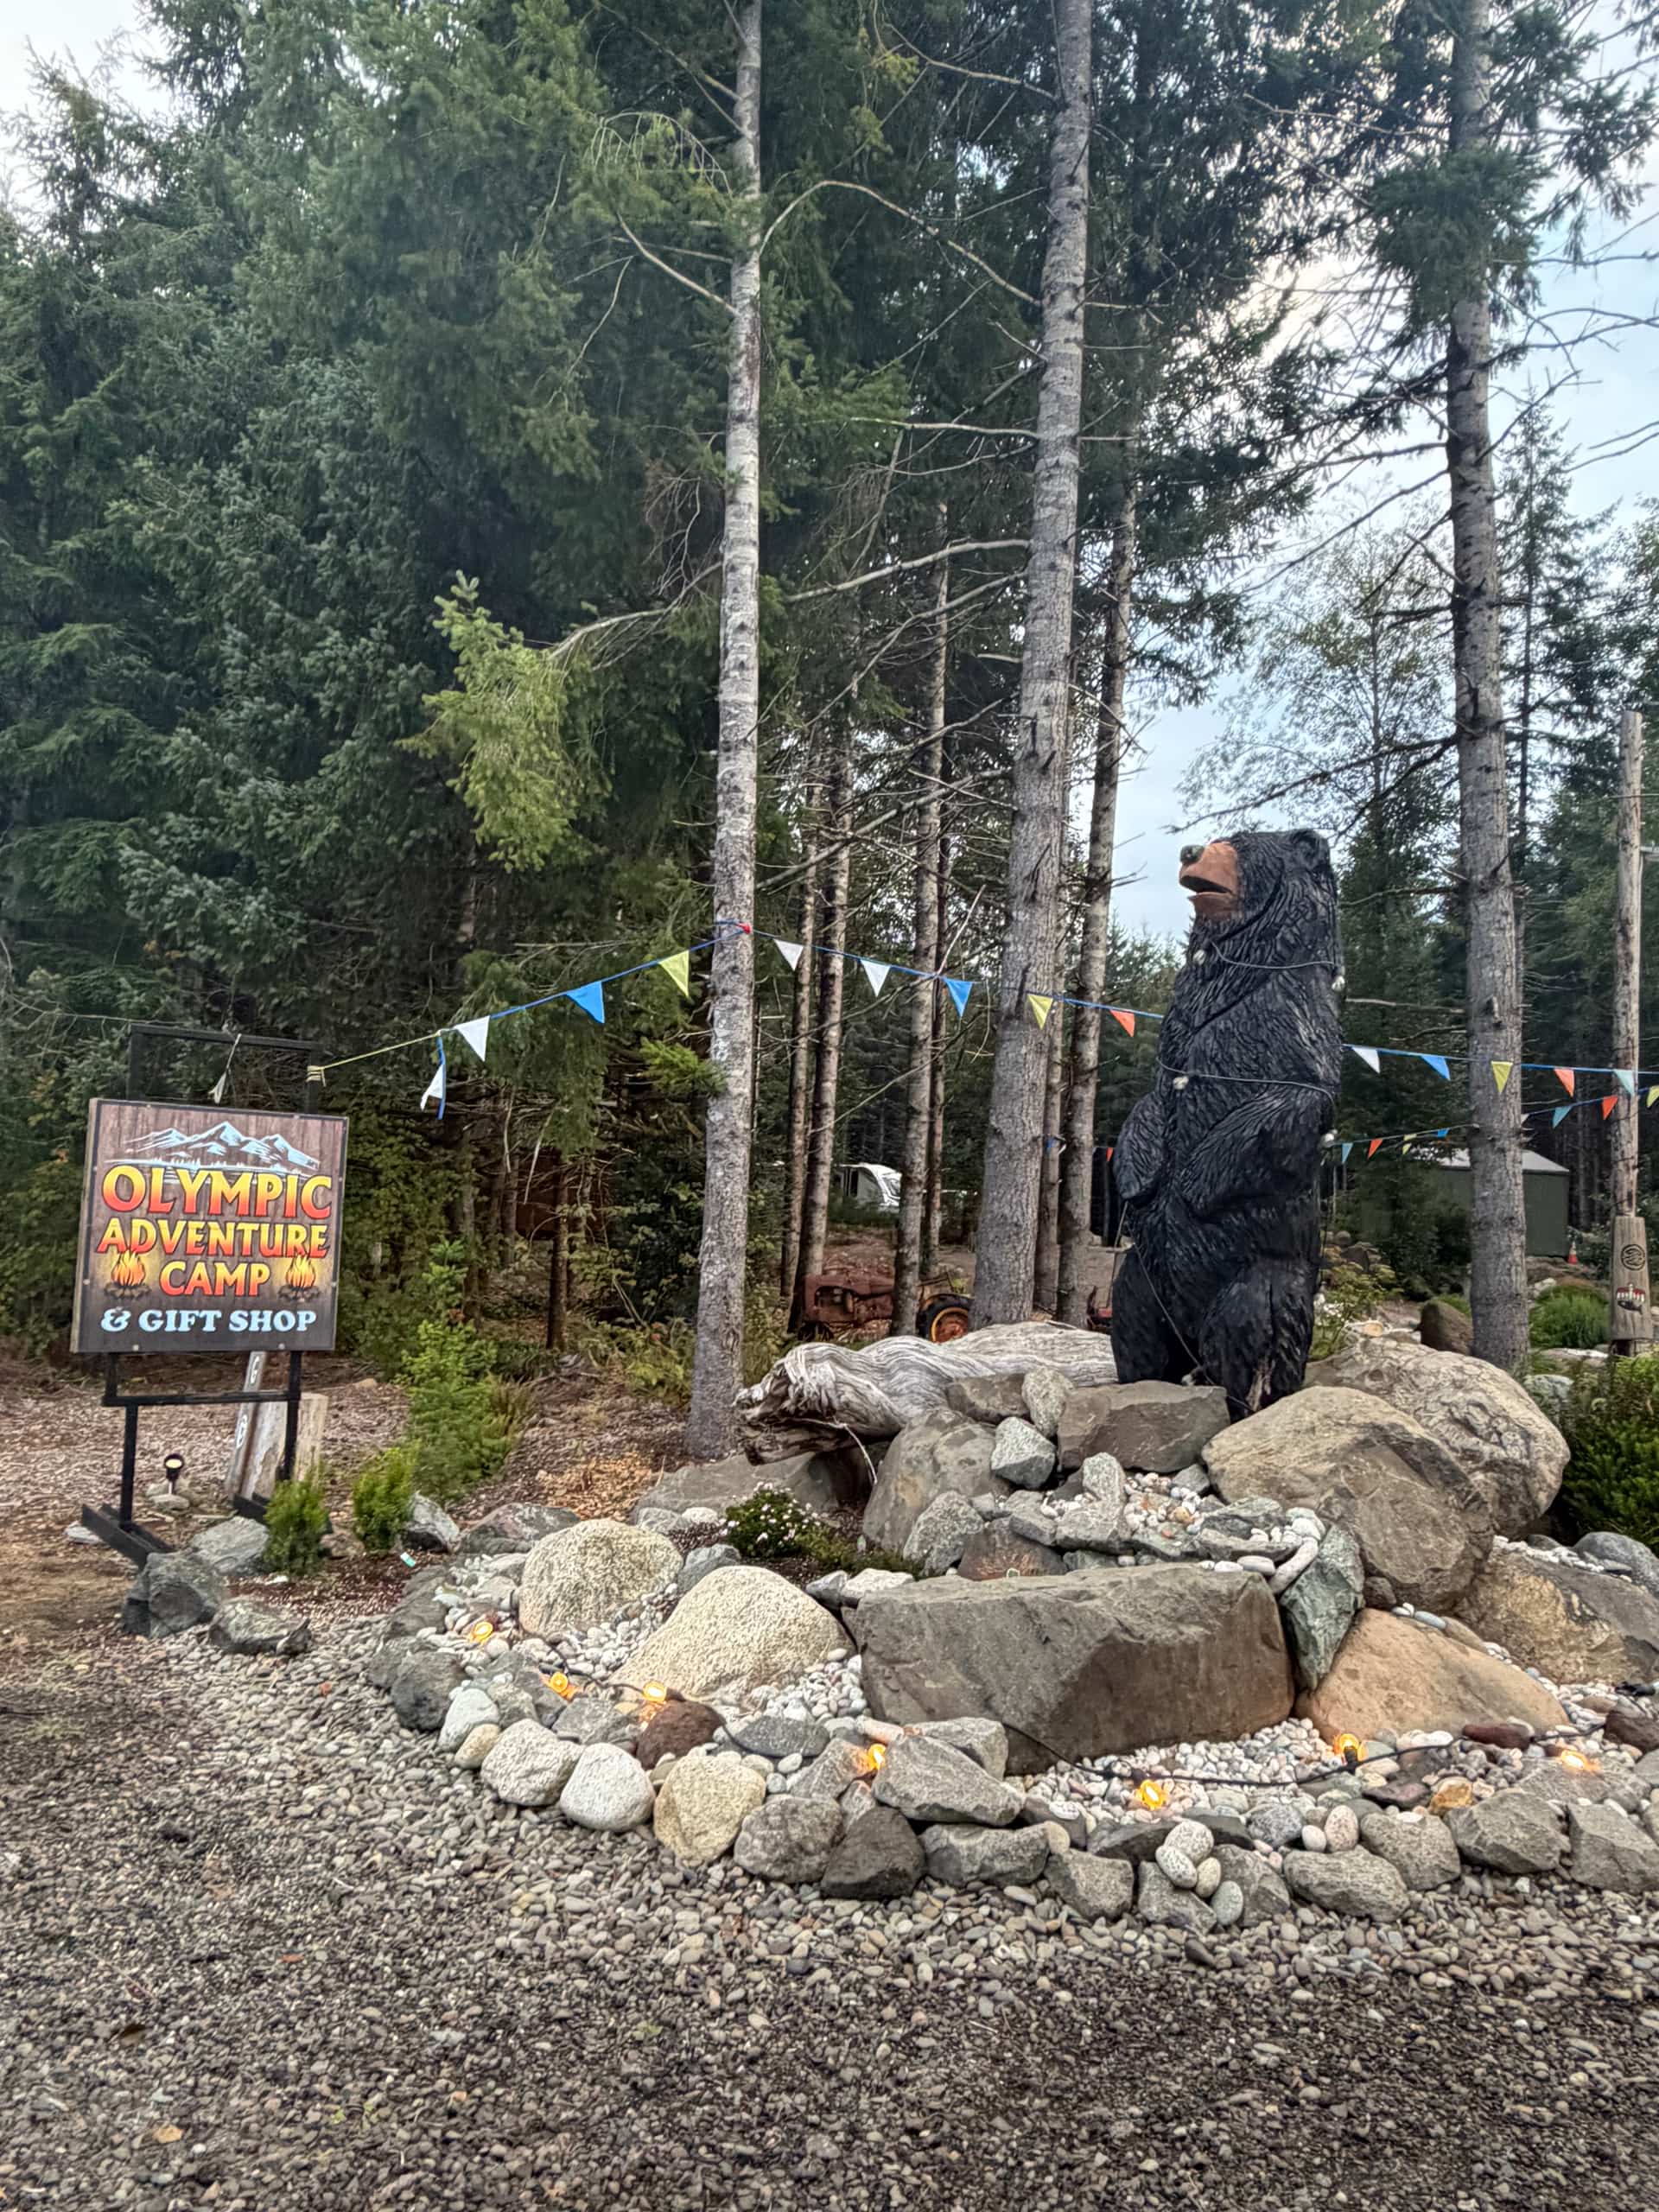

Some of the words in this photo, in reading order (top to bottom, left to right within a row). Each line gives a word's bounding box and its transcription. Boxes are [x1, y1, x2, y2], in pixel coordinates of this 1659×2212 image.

[102, 1164, 332, 1219] OLYMPIC
[97, 1218, 328, 1258] ADVENTURE
[159, 1261, 270, 1296] CAMP
[100, 1308, 131, 1332] &
[138, 1309, 222, 1332] GIFT
[229, 1310, 317, 1332] SHOP
